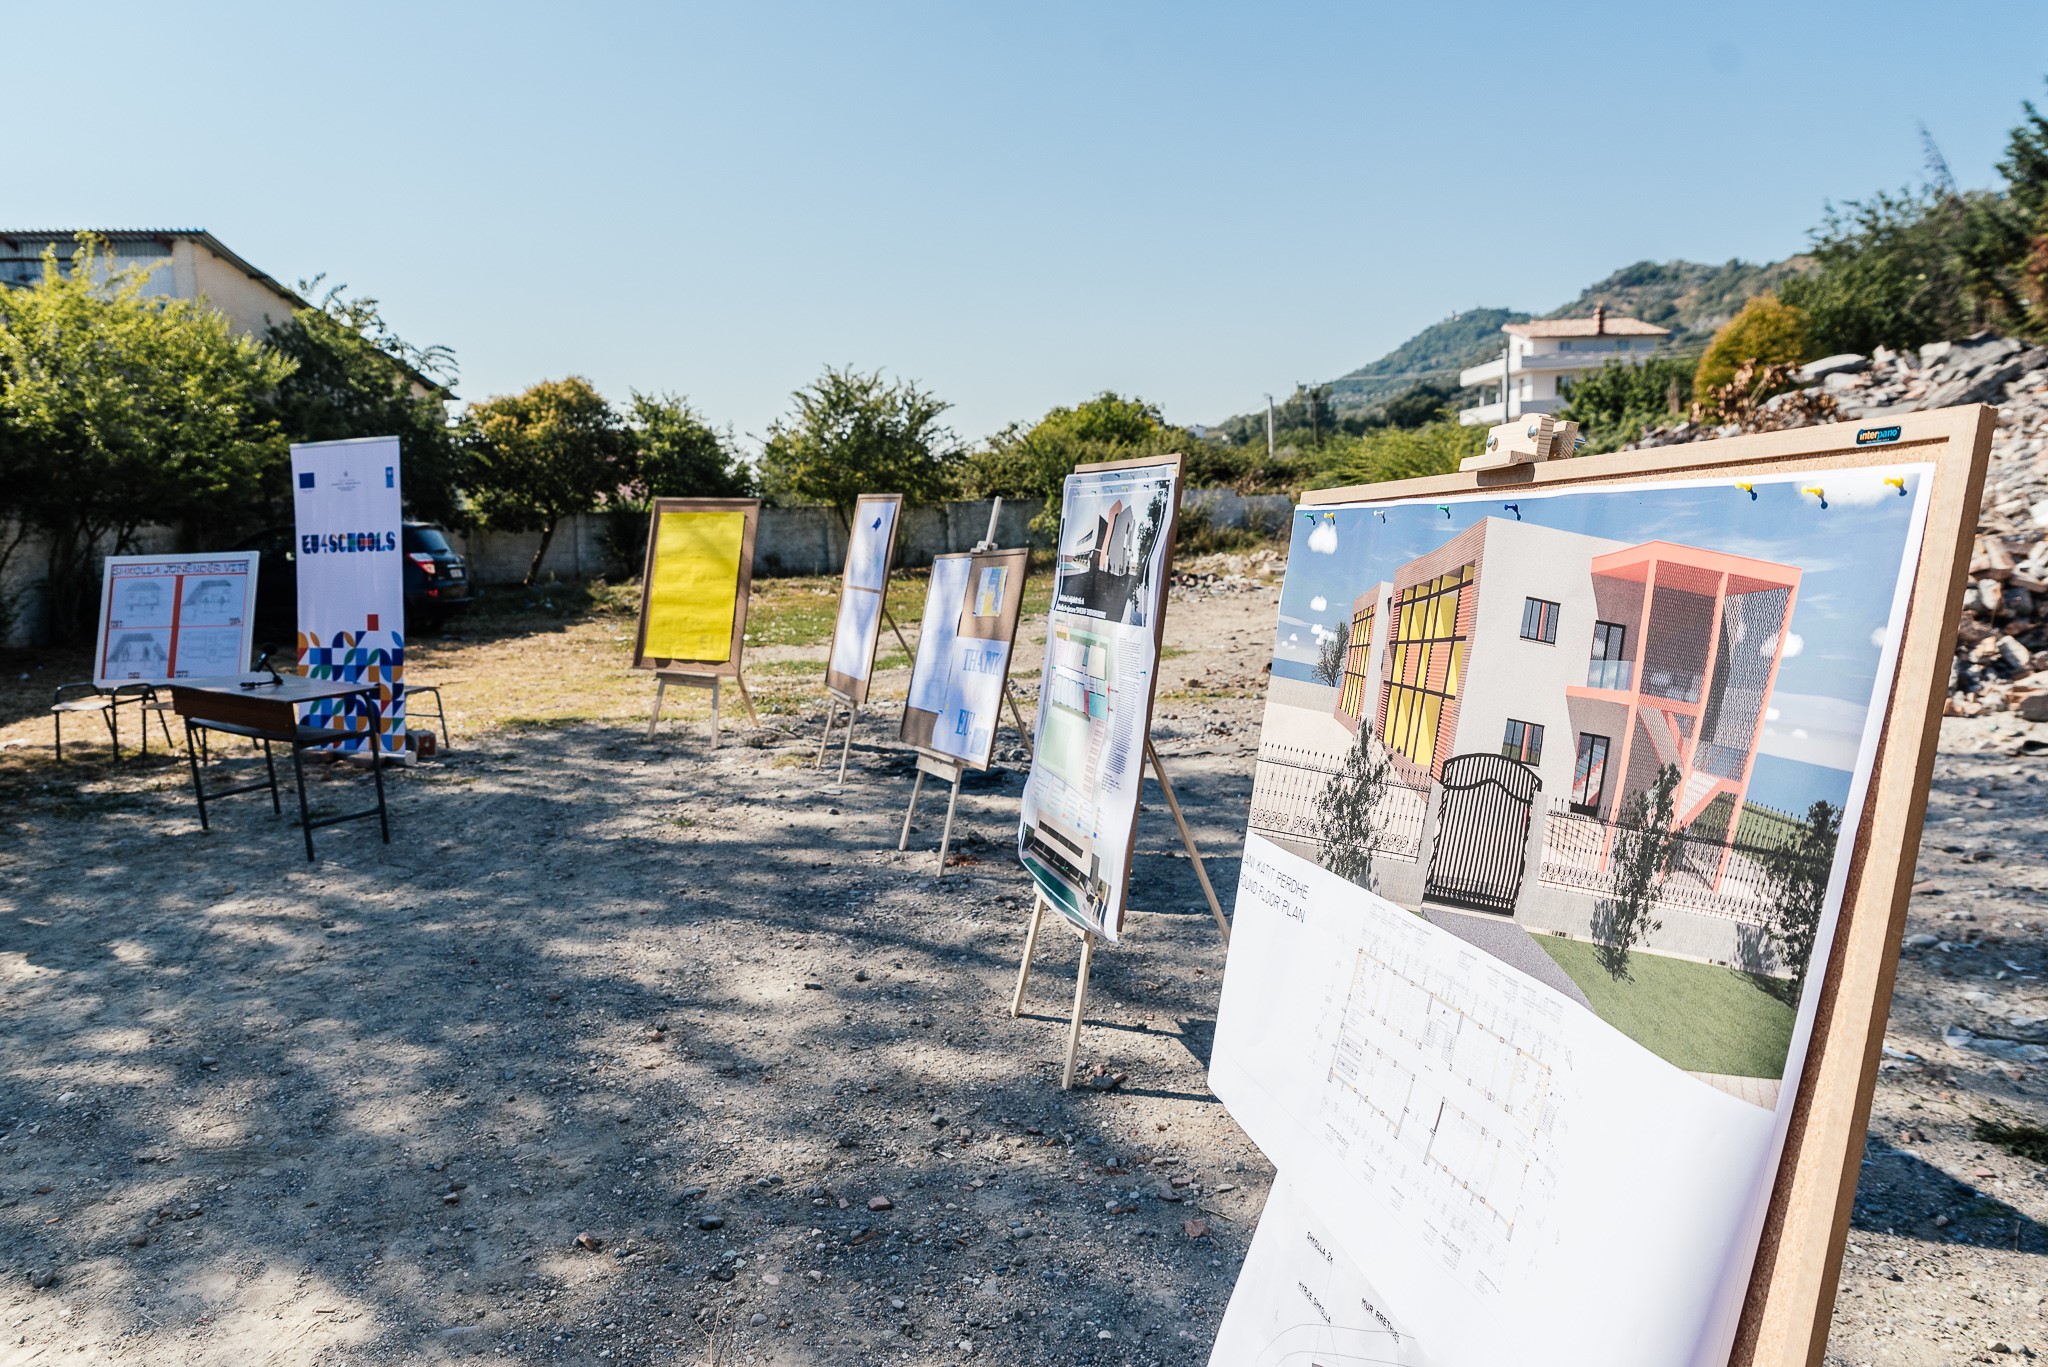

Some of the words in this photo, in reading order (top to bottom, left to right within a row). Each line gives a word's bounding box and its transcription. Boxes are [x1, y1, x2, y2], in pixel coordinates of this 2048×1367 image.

[301, 531, 396, 554] EU4SCHOOLS
[962, 648, 1003, 676] THANK
[1276, 871, 1310, 900] PERDHE
[1259, 885, 1281, 910] FLOOR
[1281, 899, 1306, 923] PLAN
[1306, 1231, 1326, 1256] SHKOLLA
[1361, 1297, 1374, 1314] MUR
